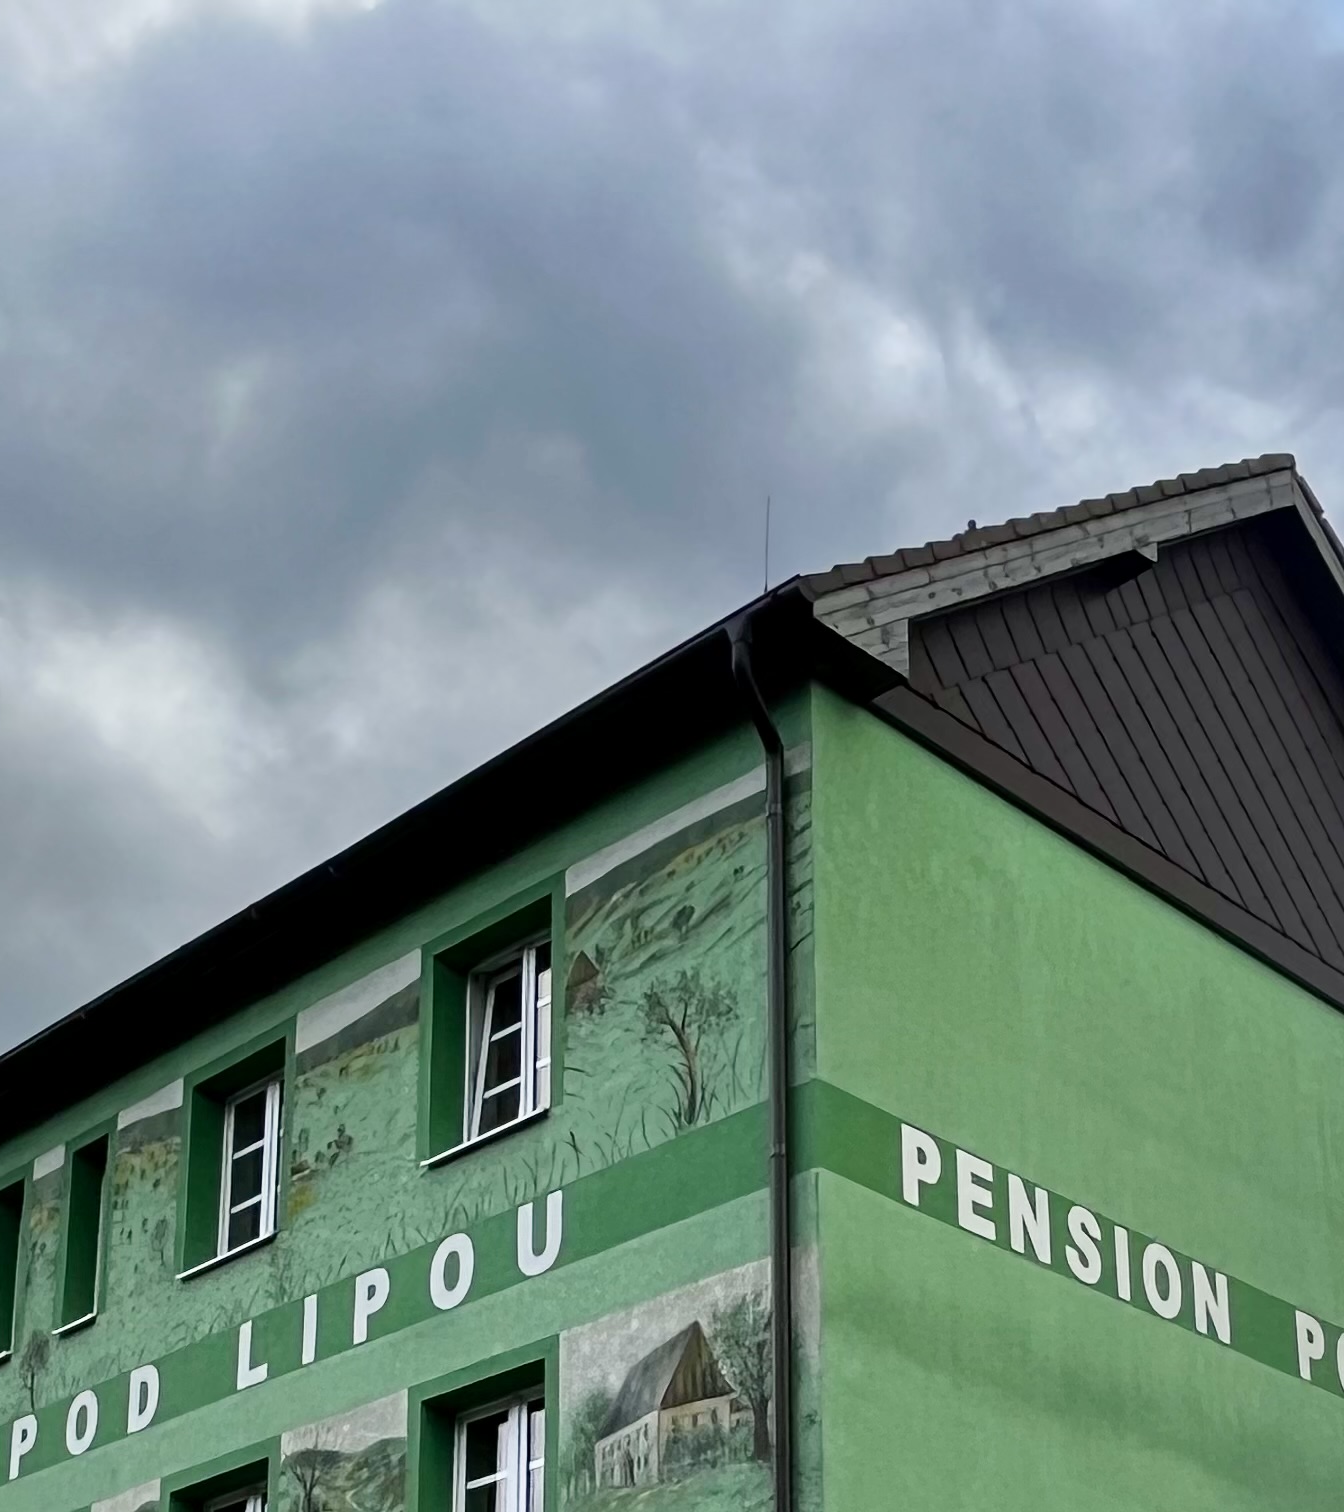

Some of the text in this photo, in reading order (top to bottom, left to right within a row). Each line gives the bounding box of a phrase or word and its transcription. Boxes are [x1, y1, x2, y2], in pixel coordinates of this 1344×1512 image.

[9, 1365, 161, 1480] POD
[237, 1190, 564, 1390] LIPOU
[901, 1123, 1232, 1345] PENSION
